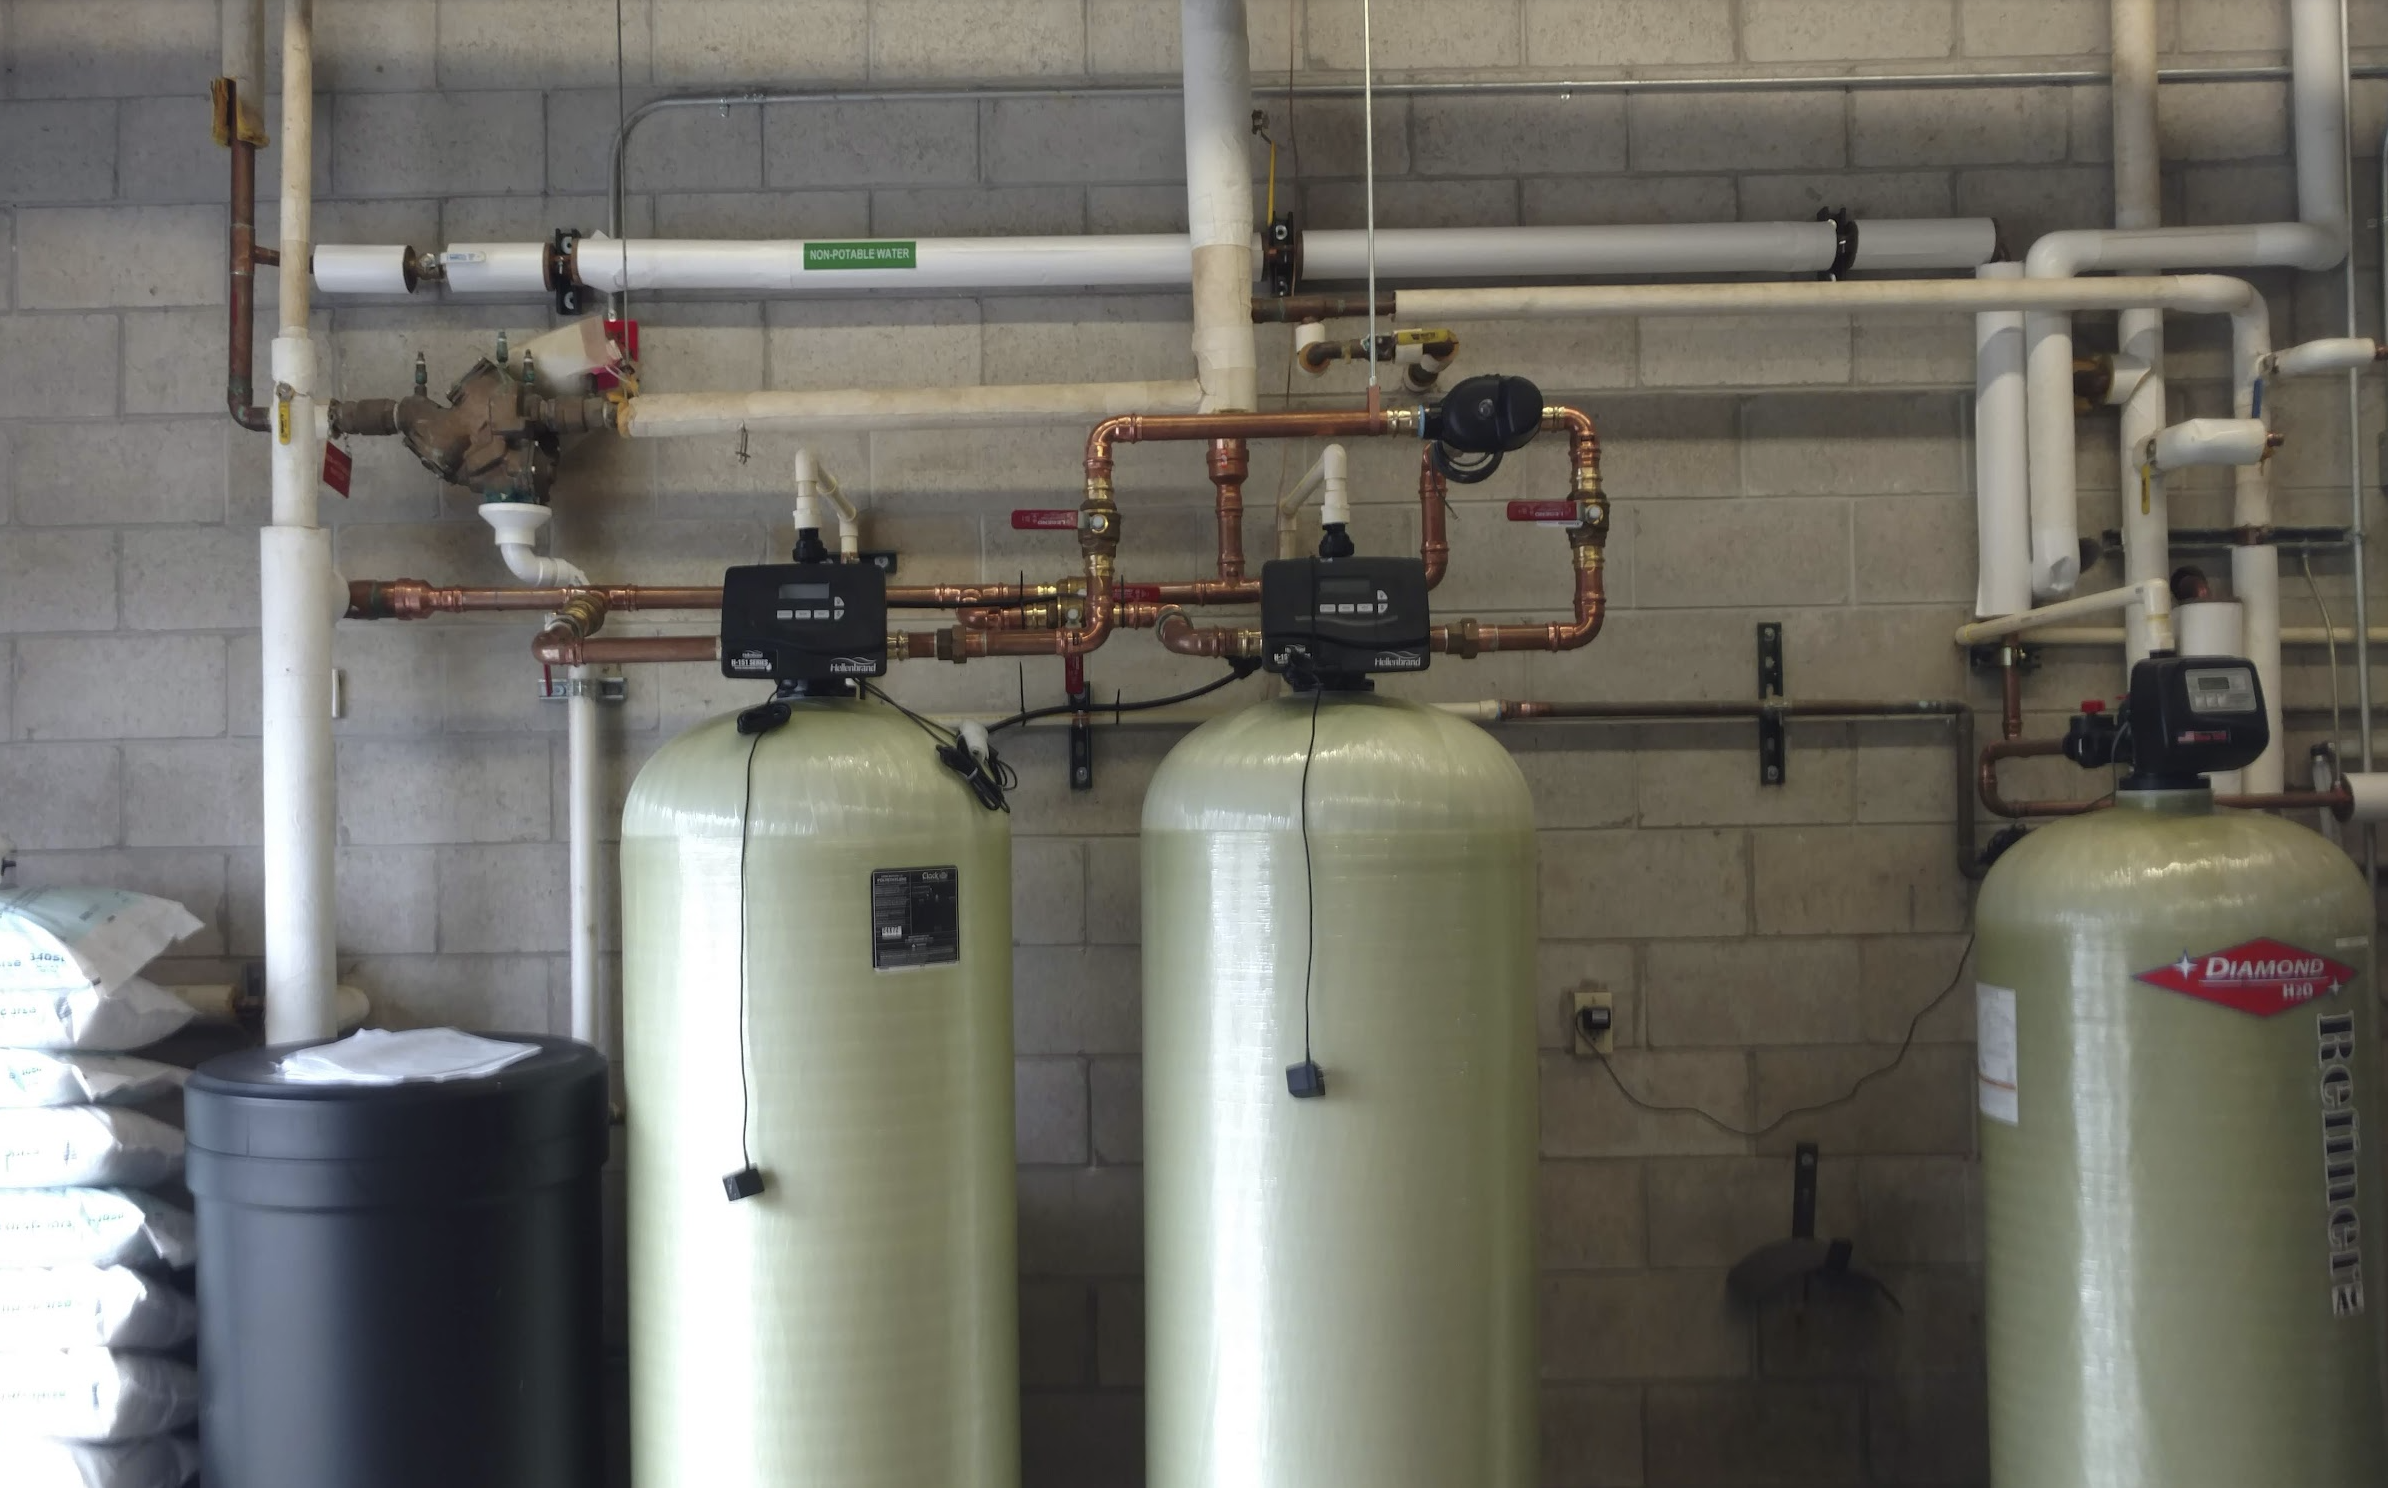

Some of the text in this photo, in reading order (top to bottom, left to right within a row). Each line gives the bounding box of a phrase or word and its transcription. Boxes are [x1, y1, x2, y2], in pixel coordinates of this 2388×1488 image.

[810, 248, 910, 260] NON-POTABLE WATER
[1374, 656, 1421, 666] Hellenbrand
[830, 662, 877, 672] Hellenbrand
[2205, 956, 2325, 979] DIAMOND
